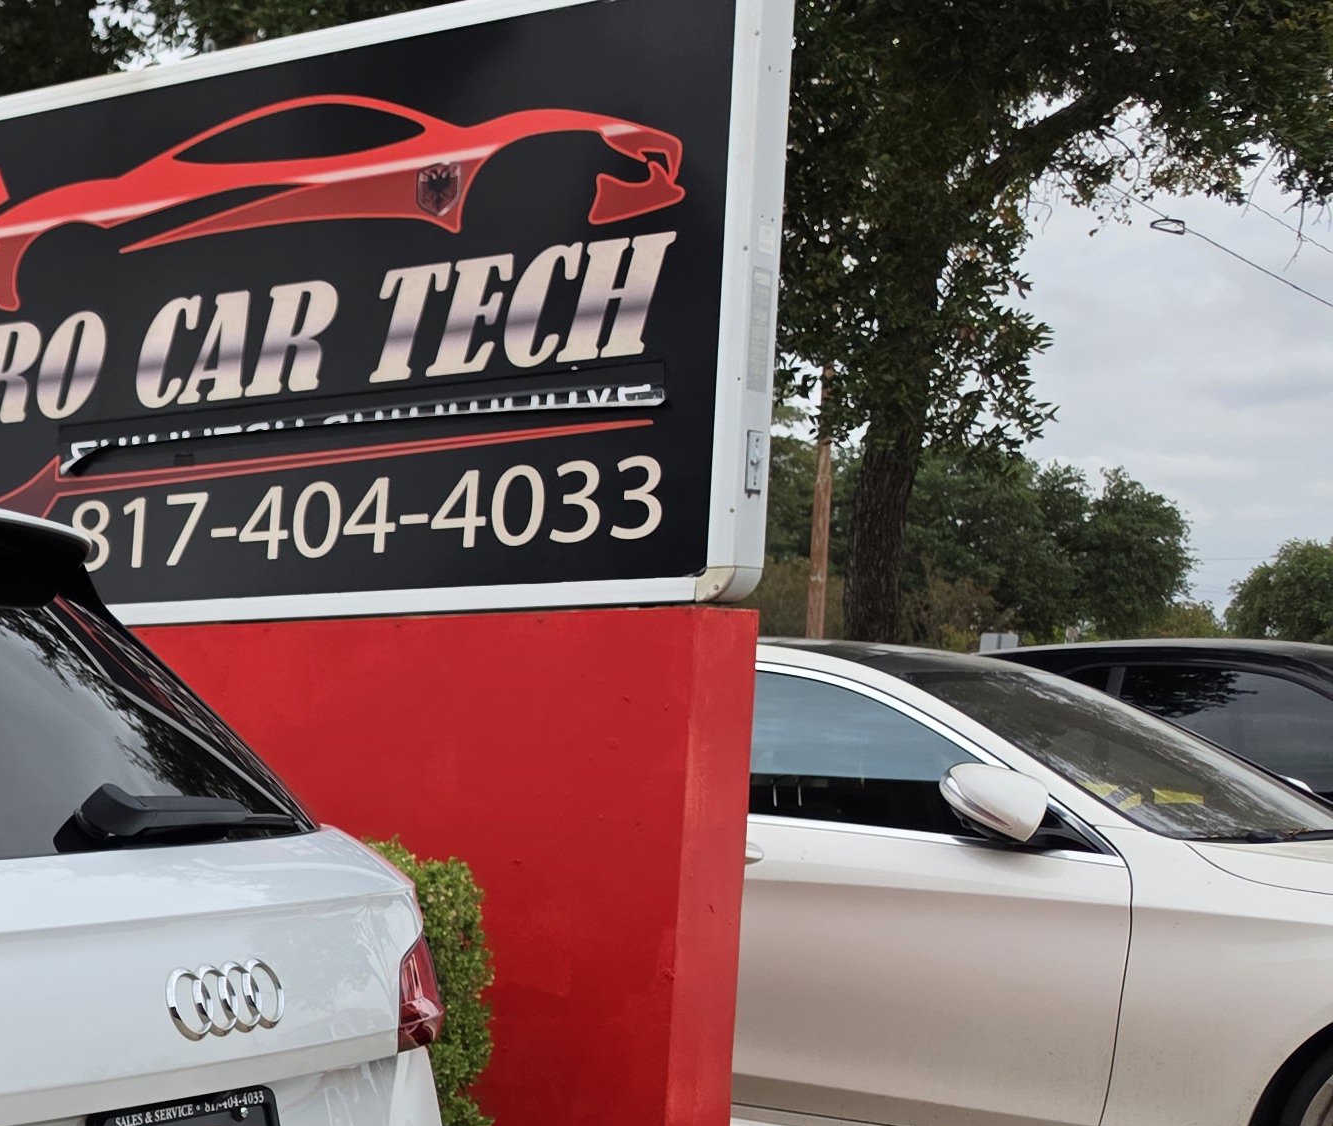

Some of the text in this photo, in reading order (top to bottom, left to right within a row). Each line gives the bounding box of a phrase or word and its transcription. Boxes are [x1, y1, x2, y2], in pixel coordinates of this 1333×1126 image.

[134, 278, 340, 410] CAR
[367, 229, 678, 385] TECH
[69, 454, 664, 574] 817-404-4033
[144, 1112, 153, 1124] &
[154, 1103, 194, 1122] SERVICE
